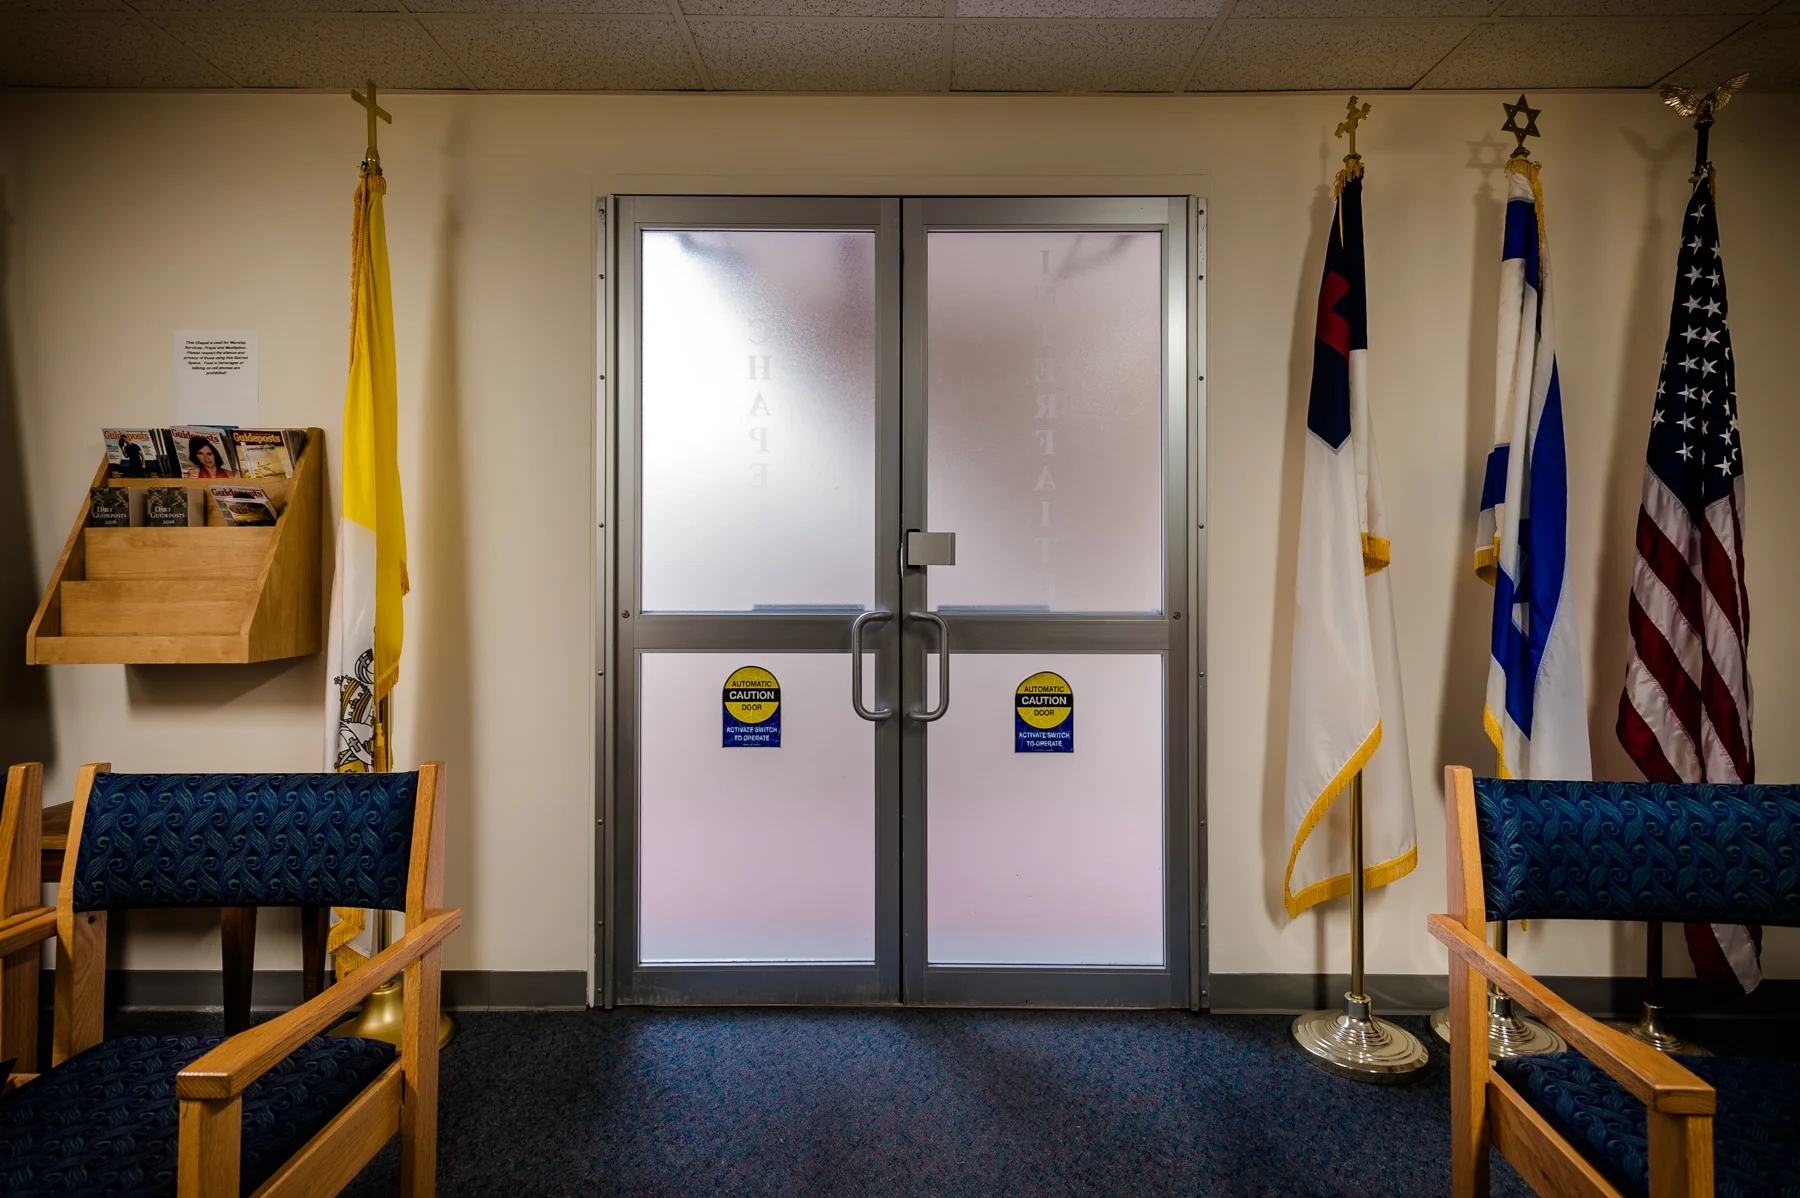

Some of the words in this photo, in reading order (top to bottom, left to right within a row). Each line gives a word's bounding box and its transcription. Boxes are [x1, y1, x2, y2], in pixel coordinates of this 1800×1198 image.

[104, 430, 150, 441] Guidposts
[232, 432, 281, 444] Guideposts
[729, 691, 774, 700] CAUTION
[1021, 696, 1067, 705] CAUTION
